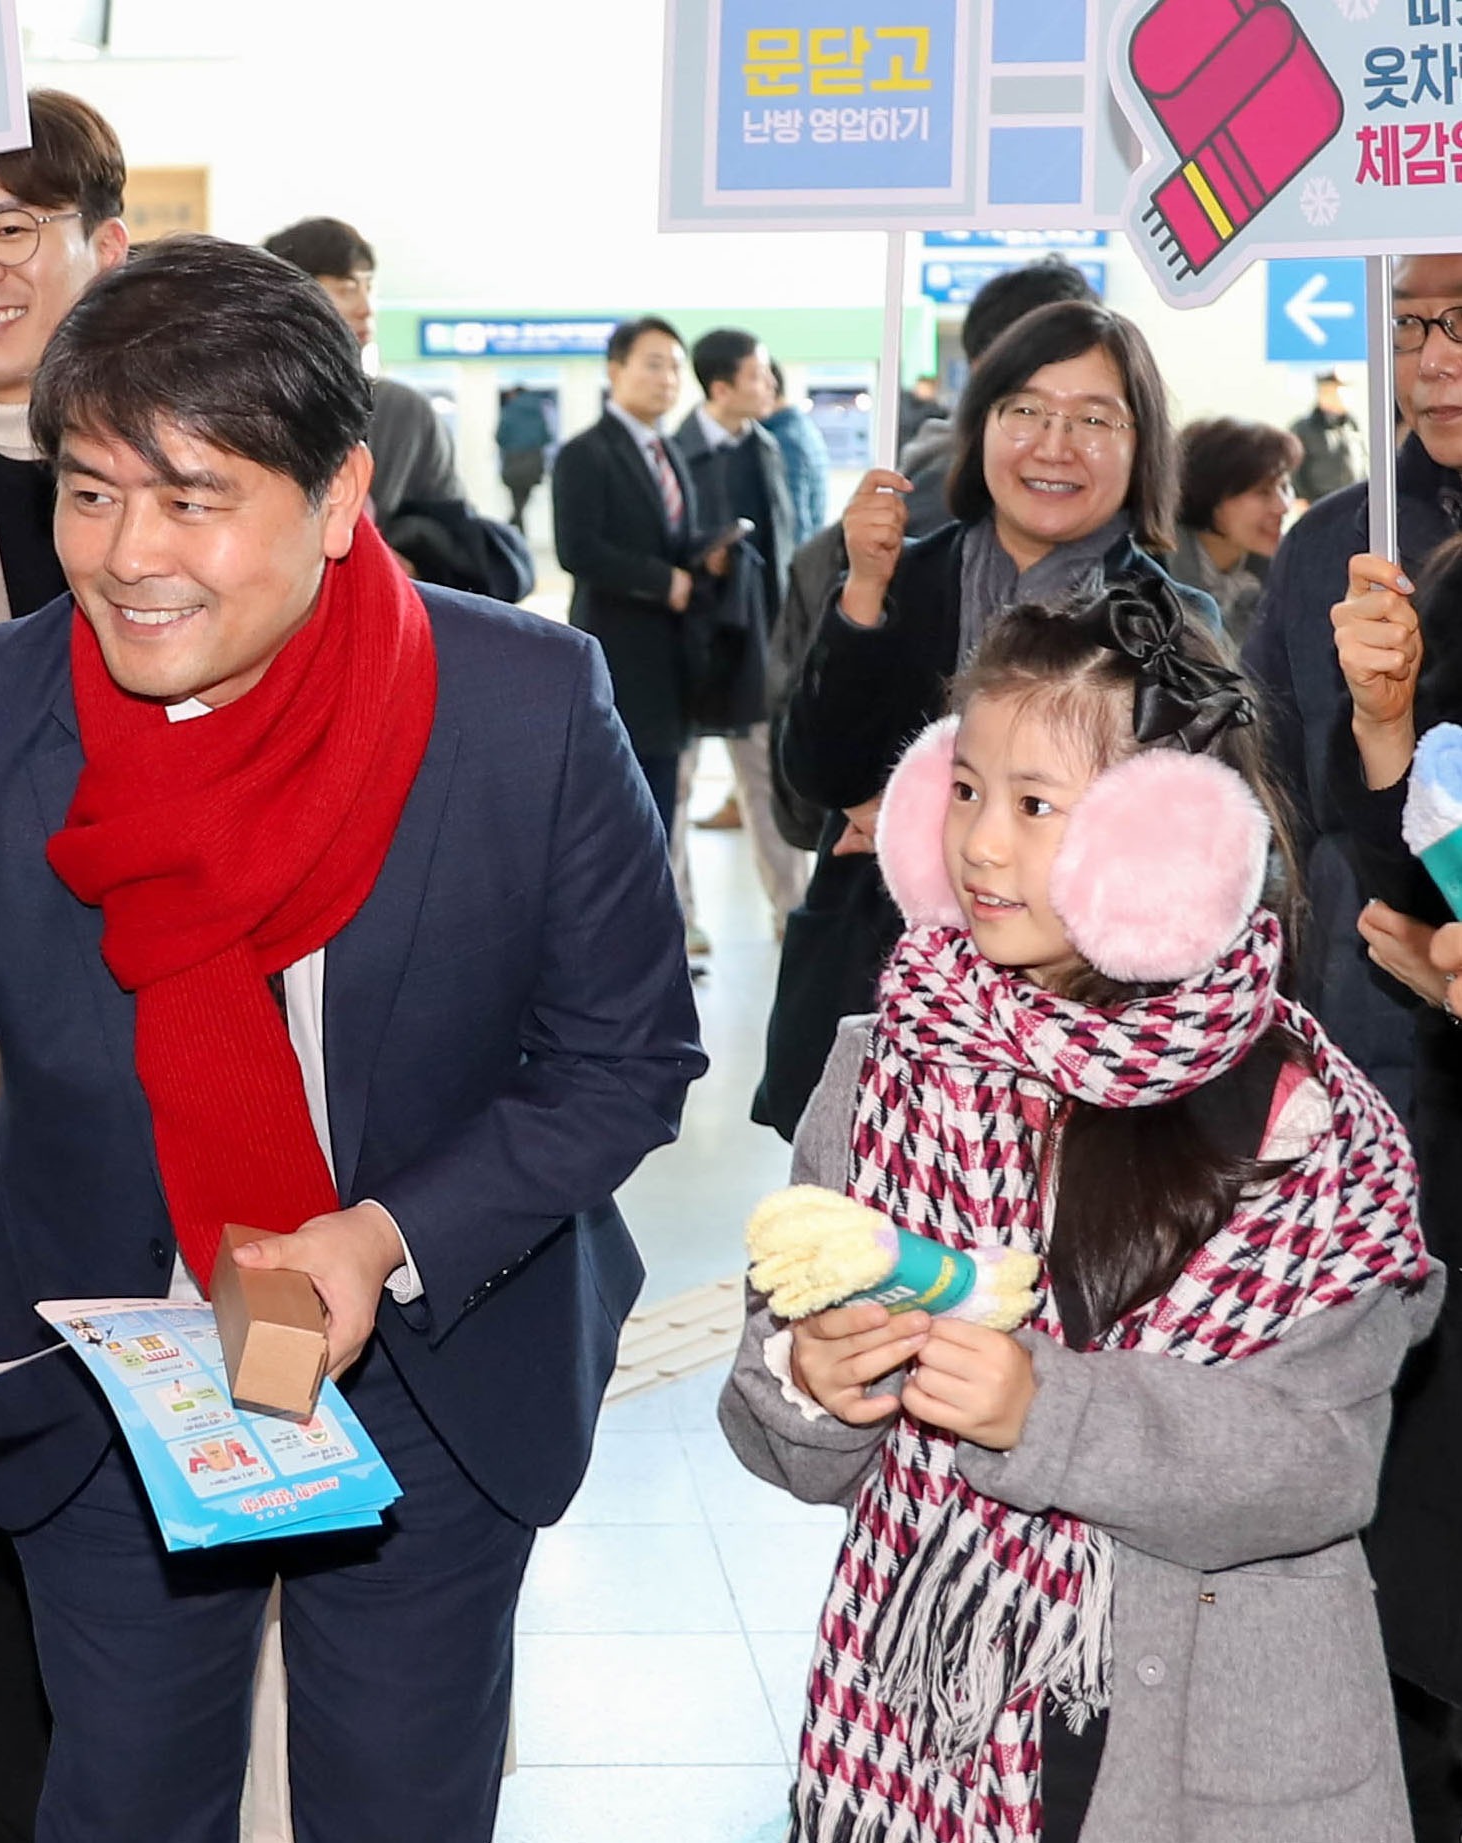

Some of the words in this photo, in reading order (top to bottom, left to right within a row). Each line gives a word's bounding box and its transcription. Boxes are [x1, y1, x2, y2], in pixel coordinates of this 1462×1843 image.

[742, 26, 934, 97] 문닫고
[1364, 43, 1462, 111] 옷차
[743, 109, 804, 144] 난방
[808, 106, 930, 144] 영업하기
[1355, 121, 1462, 186] 체감
